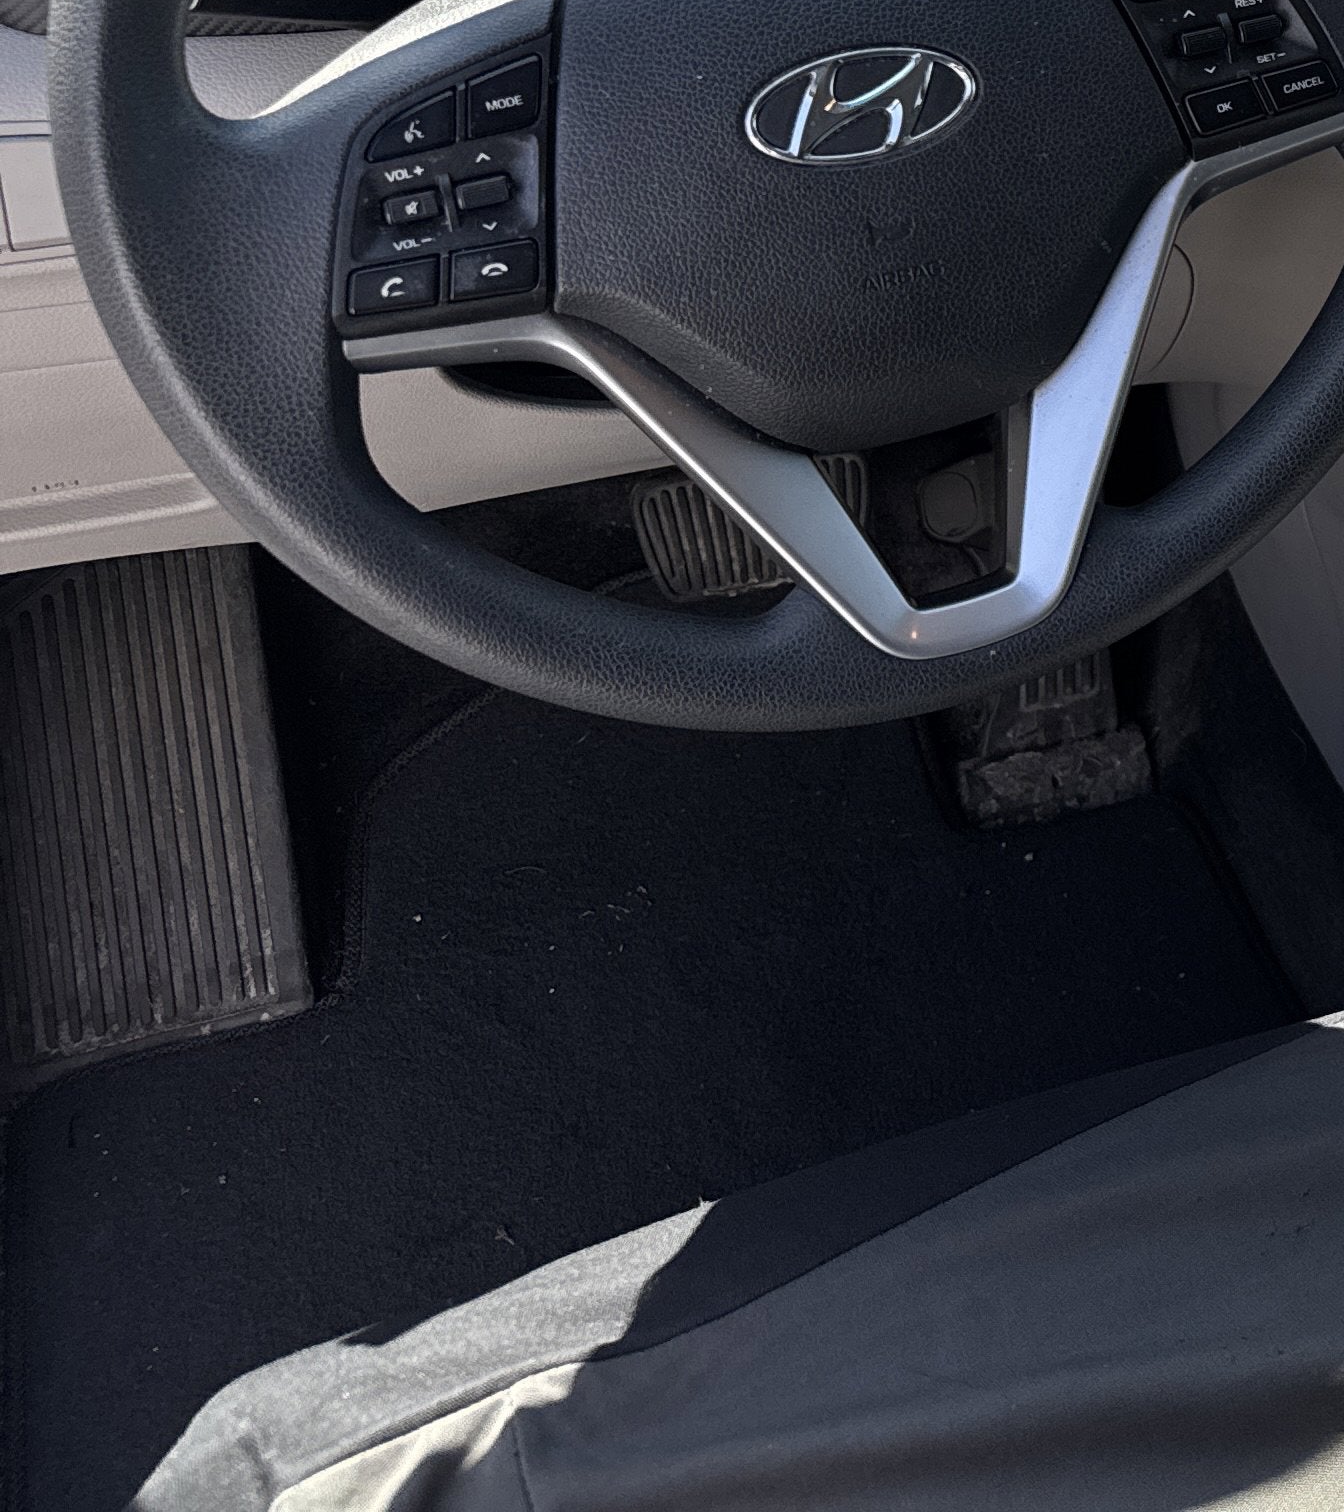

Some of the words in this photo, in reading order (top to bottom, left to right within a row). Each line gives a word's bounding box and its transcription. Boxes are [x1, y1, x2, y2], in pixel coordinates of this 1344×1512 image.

[1283, 76, 1325, 94] CANCEL
[485, 94, 524, 112] MODE
[1216, 101, 1233, 114] OK
